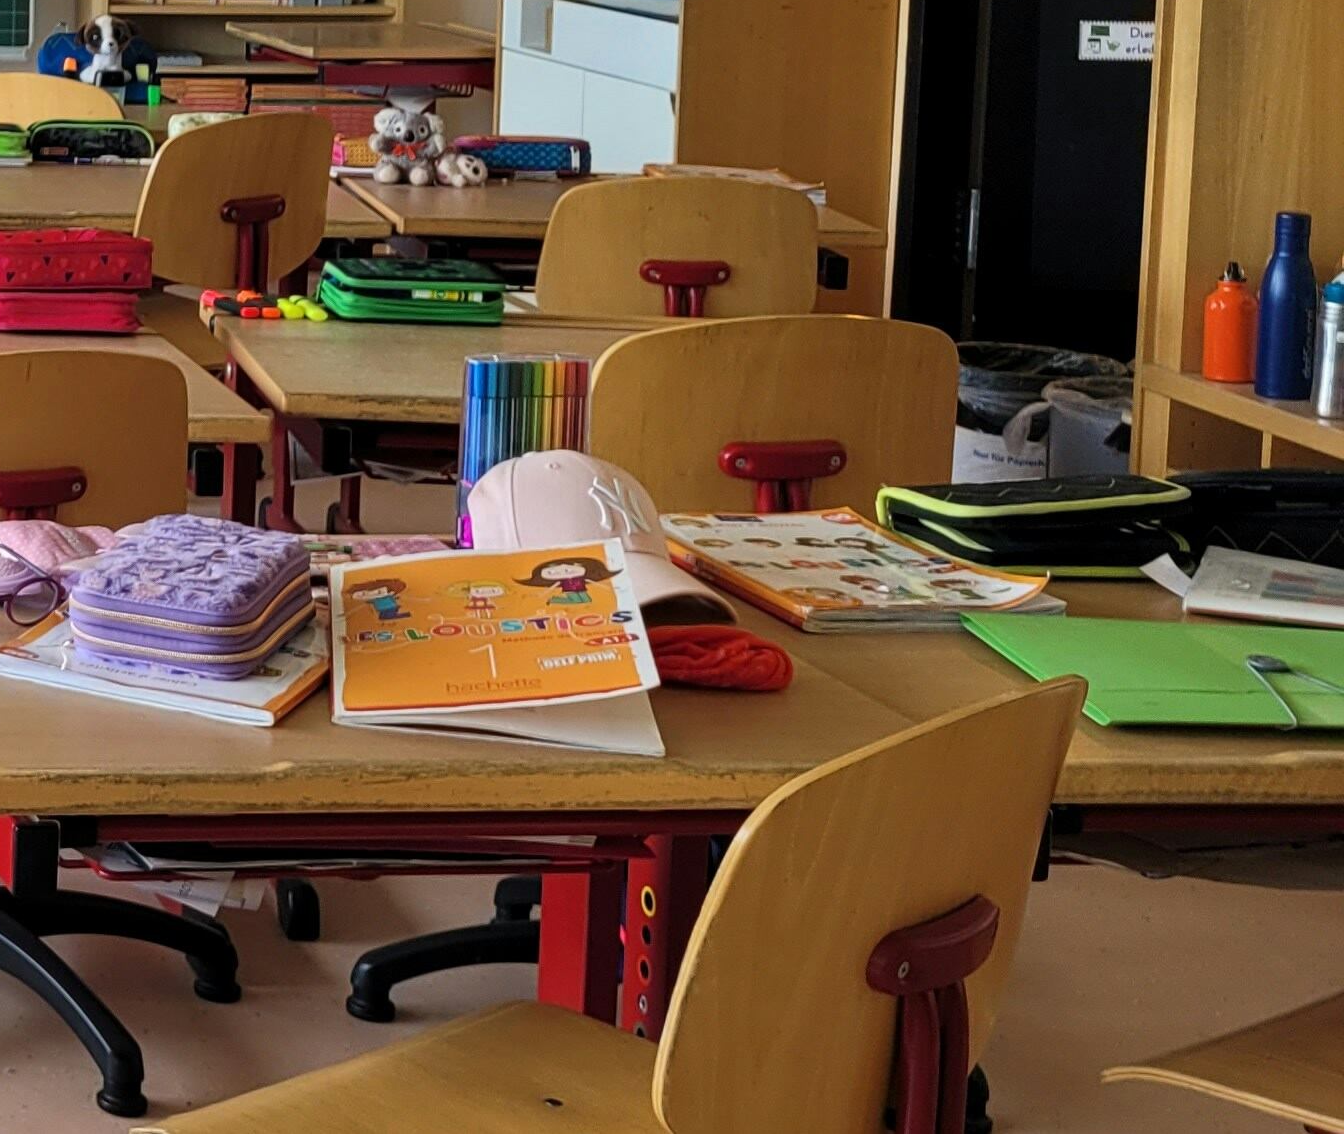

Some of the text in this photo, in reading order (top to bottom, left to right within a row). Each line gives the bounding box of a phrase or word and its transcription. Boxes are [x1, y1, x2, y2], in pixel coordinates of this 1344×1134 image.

[405, 610, 634, 642] LOUSTICS
[468, 644, 497, 680] 1
[445, 677, 542, 694] hachette
